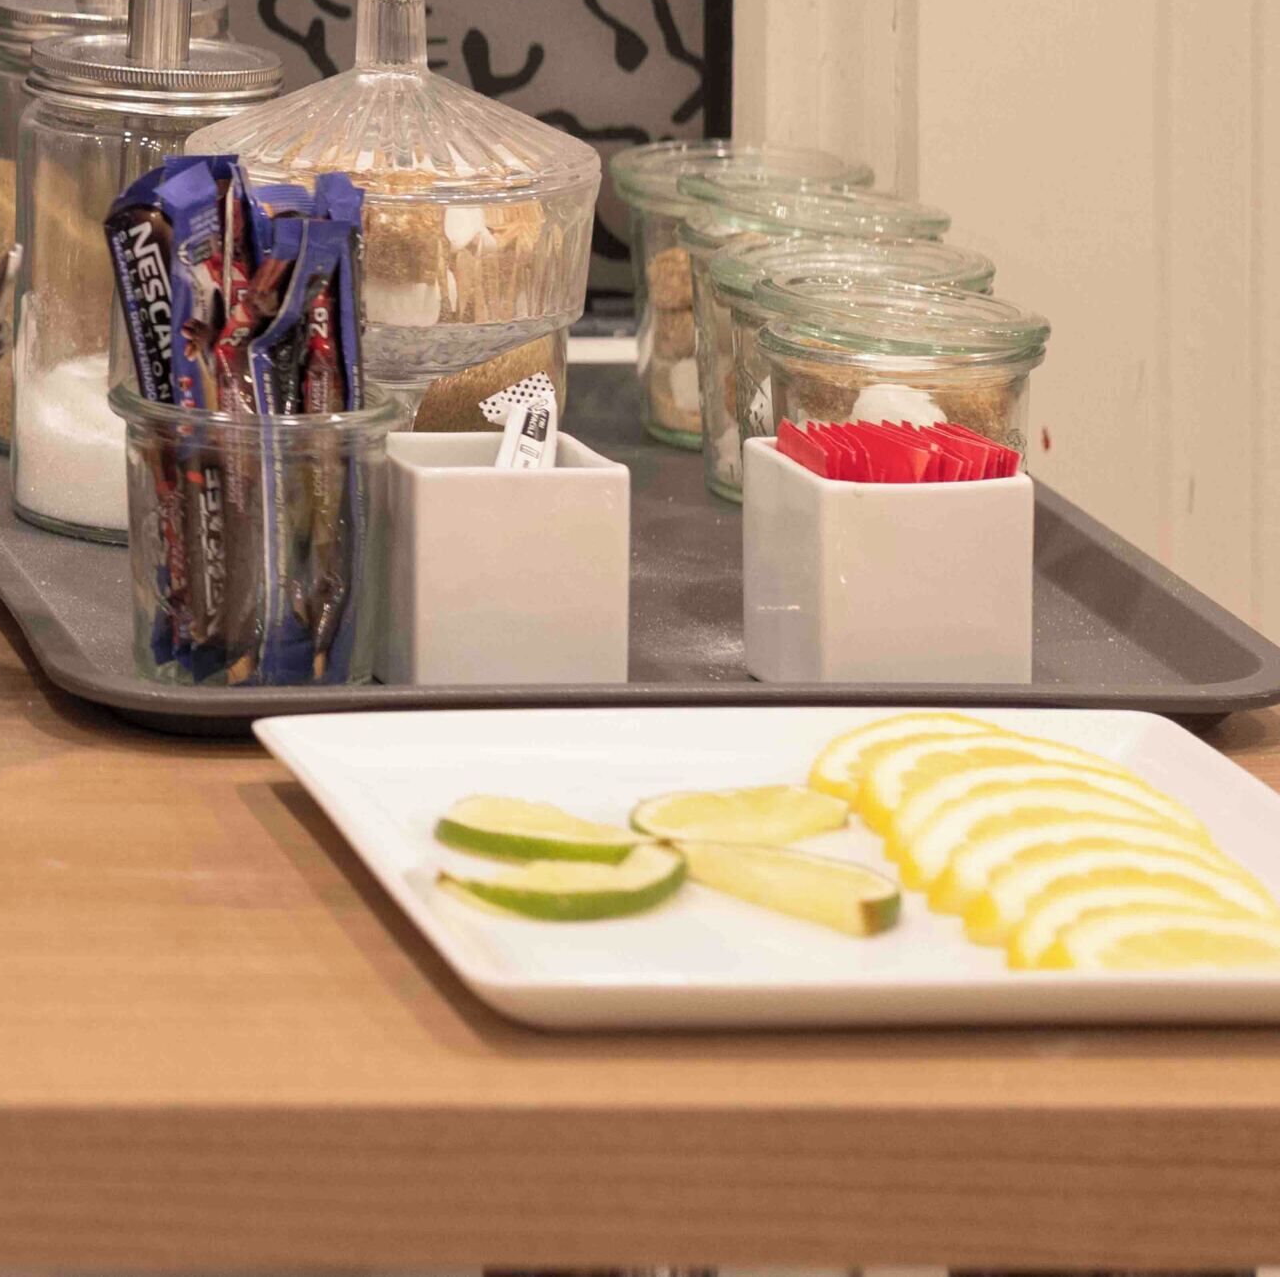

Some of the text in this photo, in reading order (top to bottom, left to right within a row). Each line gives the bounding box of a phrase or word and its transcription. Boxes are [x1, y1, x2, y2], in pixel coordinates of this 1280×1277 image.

[119, 231, 170, 401] SELECTION
[129, 221, 173, 361] NESCA
[311, 306, 329, 339] 2g
